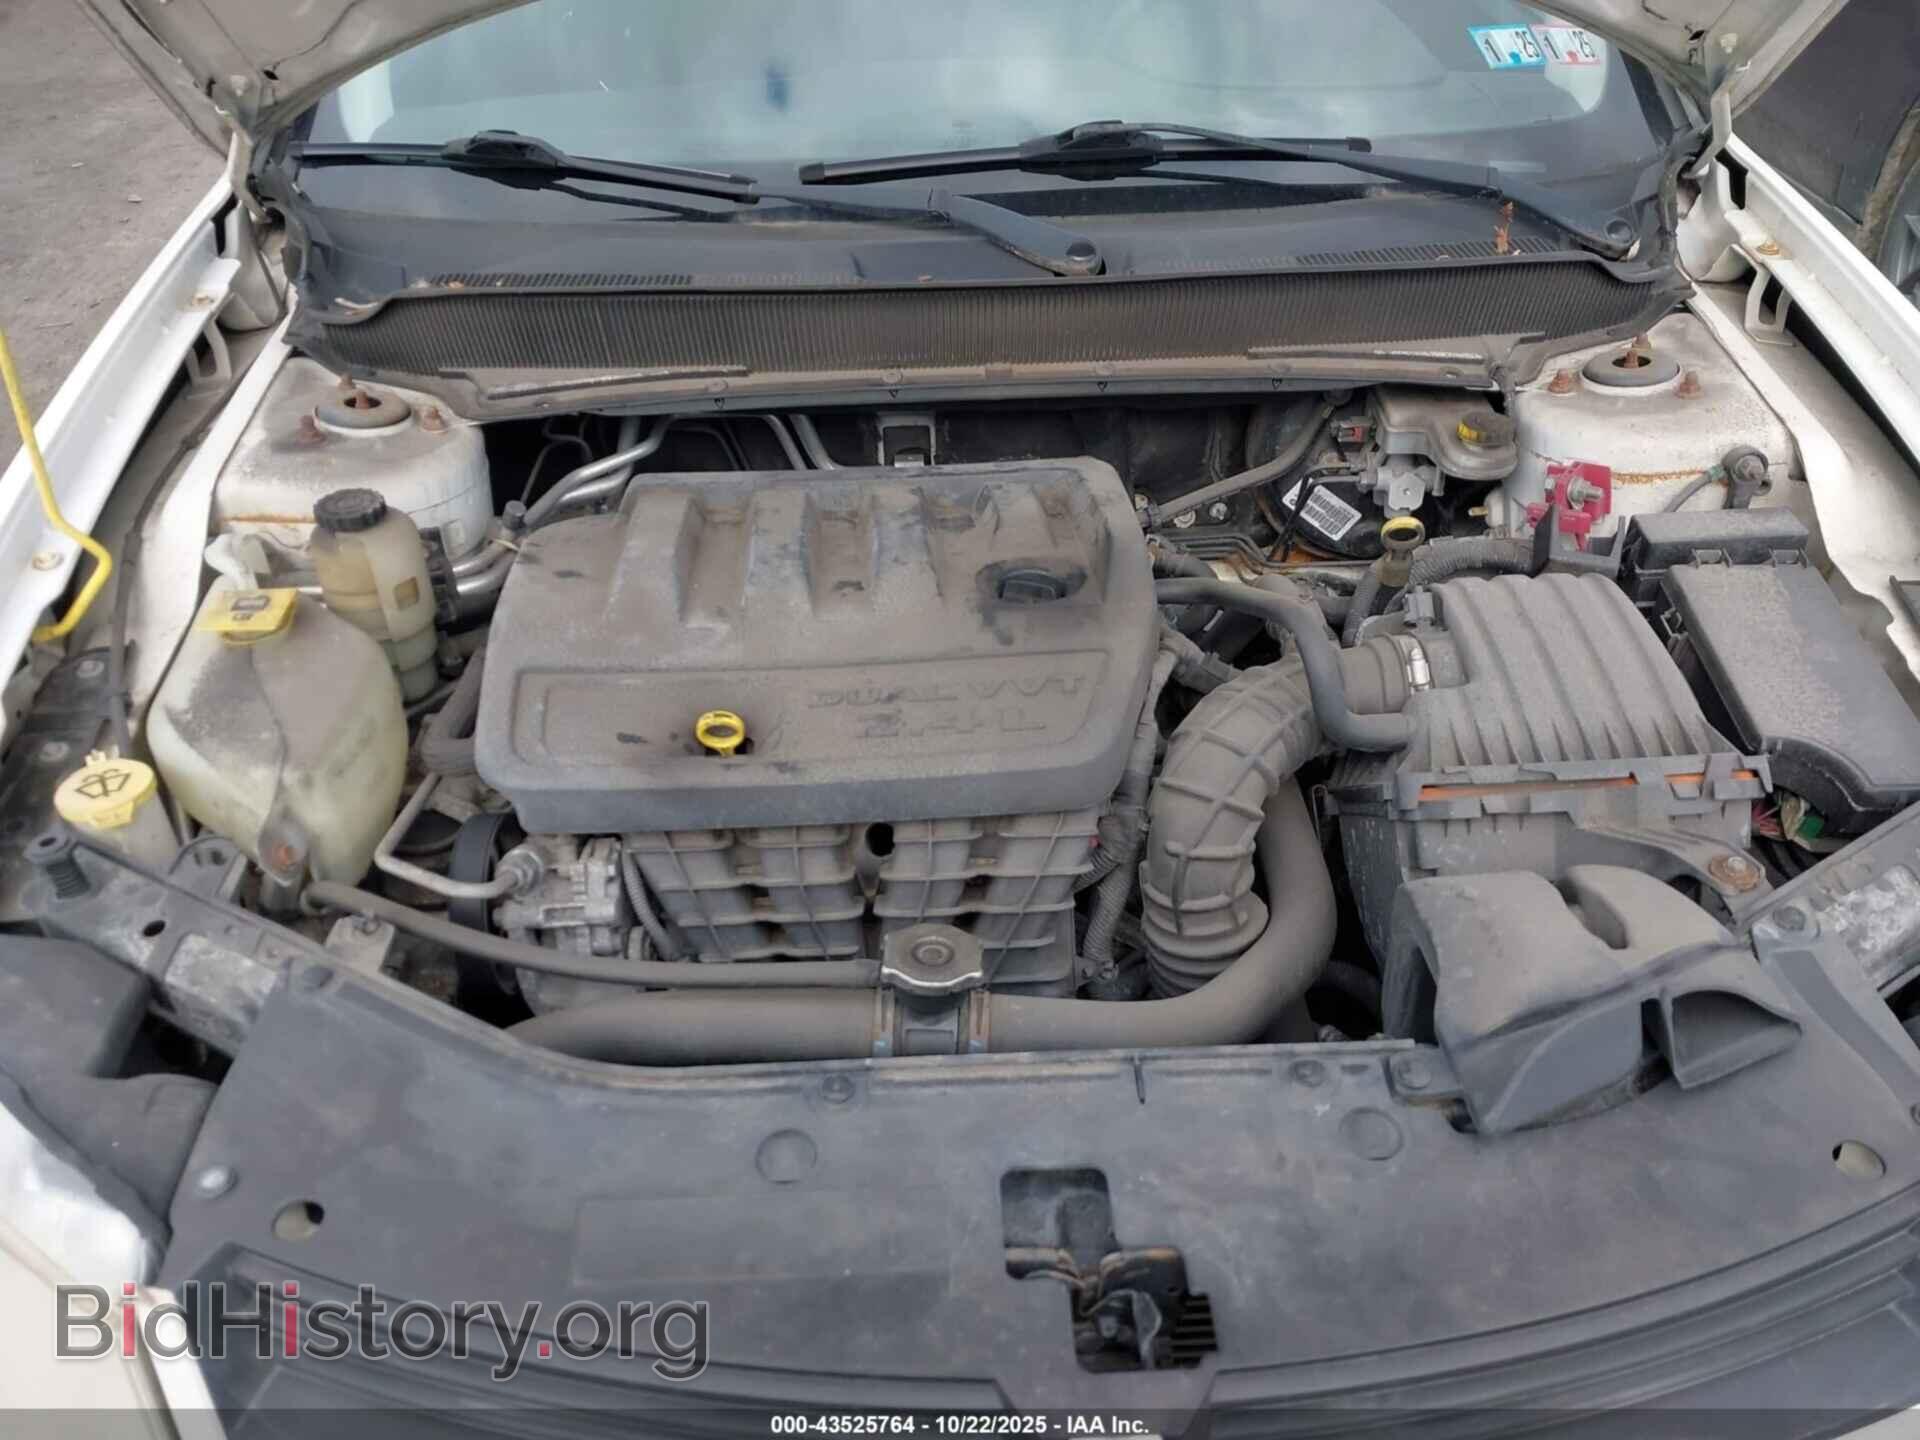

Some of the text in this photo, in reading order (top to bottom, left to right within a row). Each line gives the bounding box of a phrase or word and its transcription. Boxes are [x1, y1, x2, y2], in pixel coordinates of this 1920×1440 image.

[1484, 37, 1502, 62] 1
[1544, 35, 1560, 60] 1
[807, 682, 958, 708] DUAL
